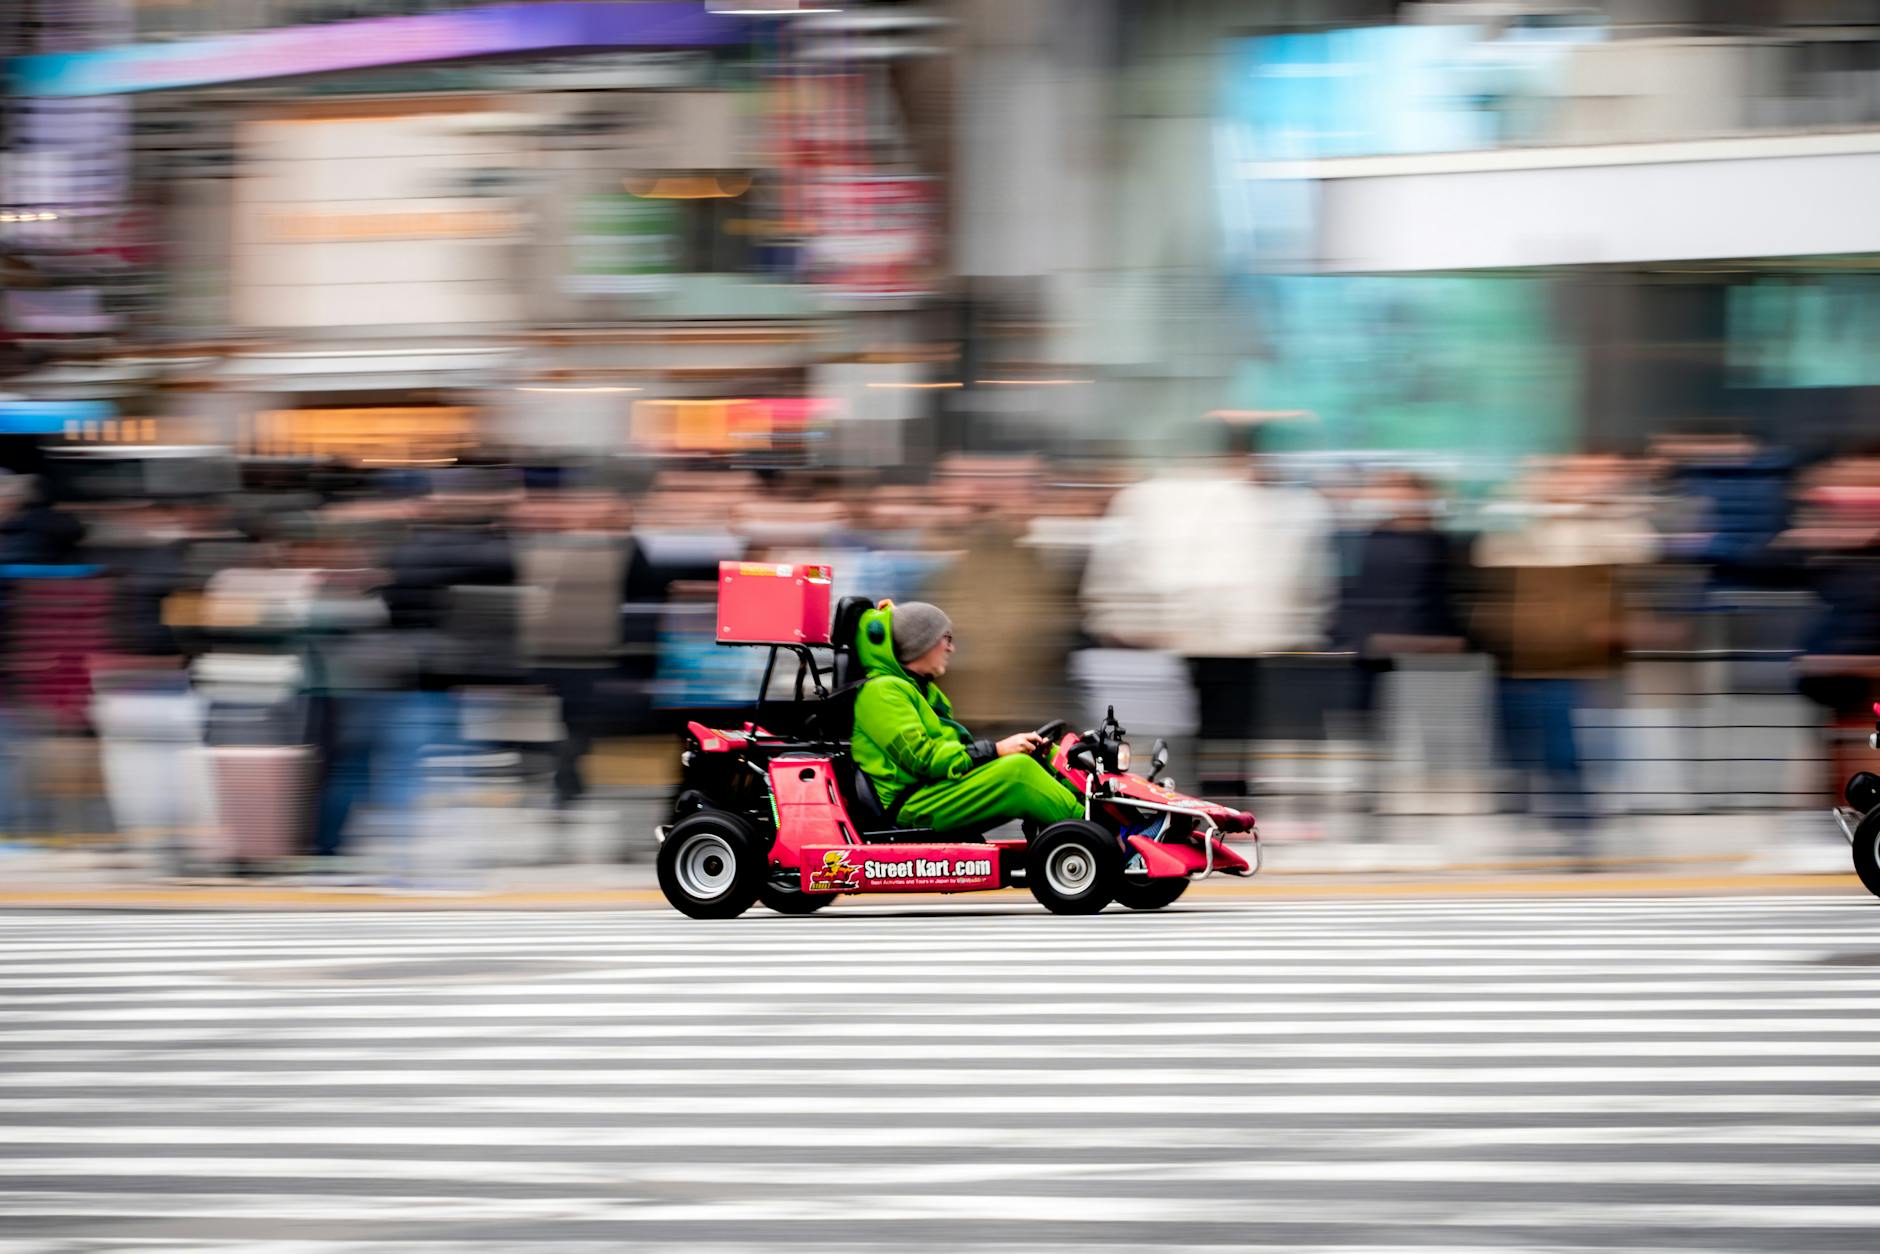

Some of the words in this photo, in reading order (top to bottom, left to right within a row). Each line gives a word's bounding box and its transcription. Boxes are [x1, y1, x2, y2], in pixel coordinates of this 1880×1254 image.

[865, 860, 914, 878] Street
[916, 859, 950, 877] Kart
[952, 860, 991, 876] .com
